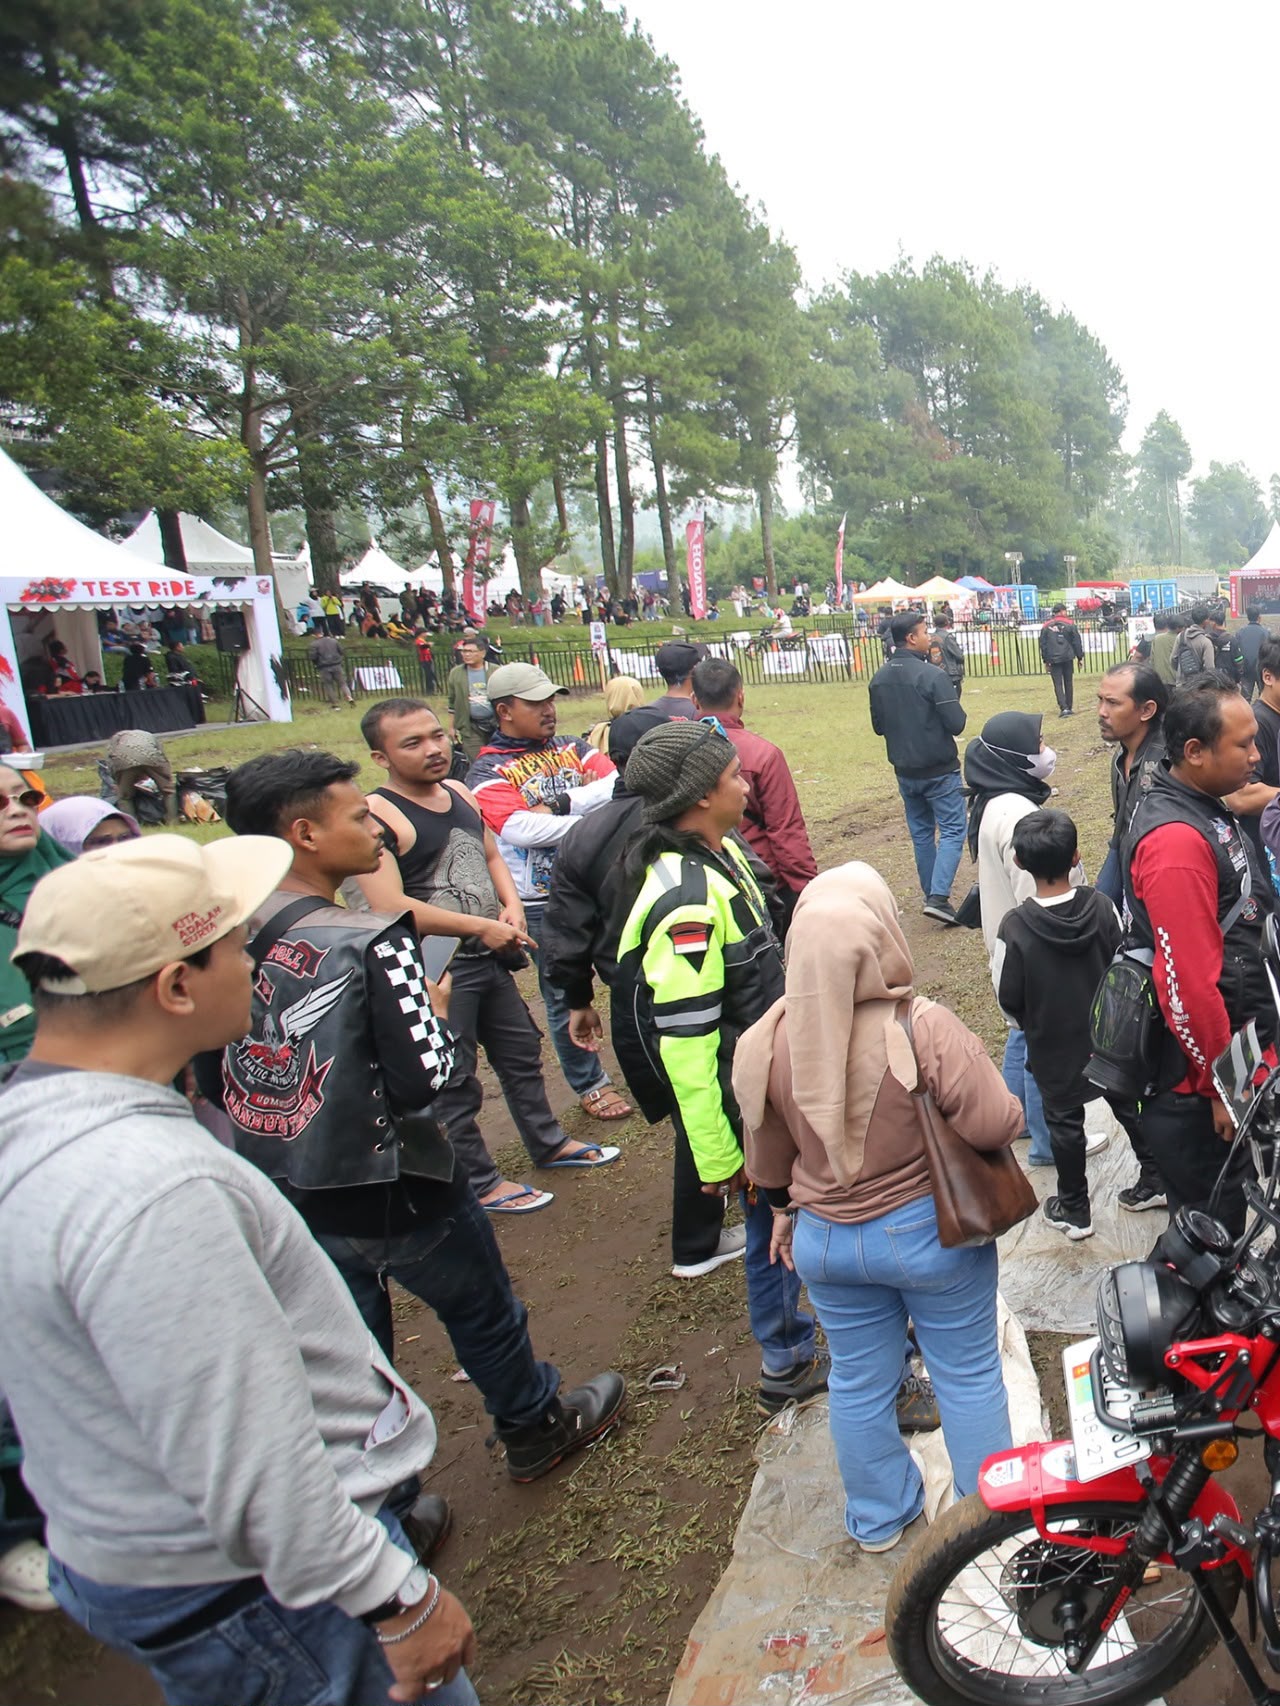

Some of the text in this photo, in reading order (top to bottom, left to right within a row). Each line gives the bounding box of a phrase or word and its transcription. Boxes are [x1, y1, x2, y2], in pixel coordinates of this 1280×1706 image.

[82, 581, 141, 597] TEST
[172, 911, 200, 932] KITA
[179, 906, 222, 939] ADALAH
[182, 922, 218, 947] SURYA
